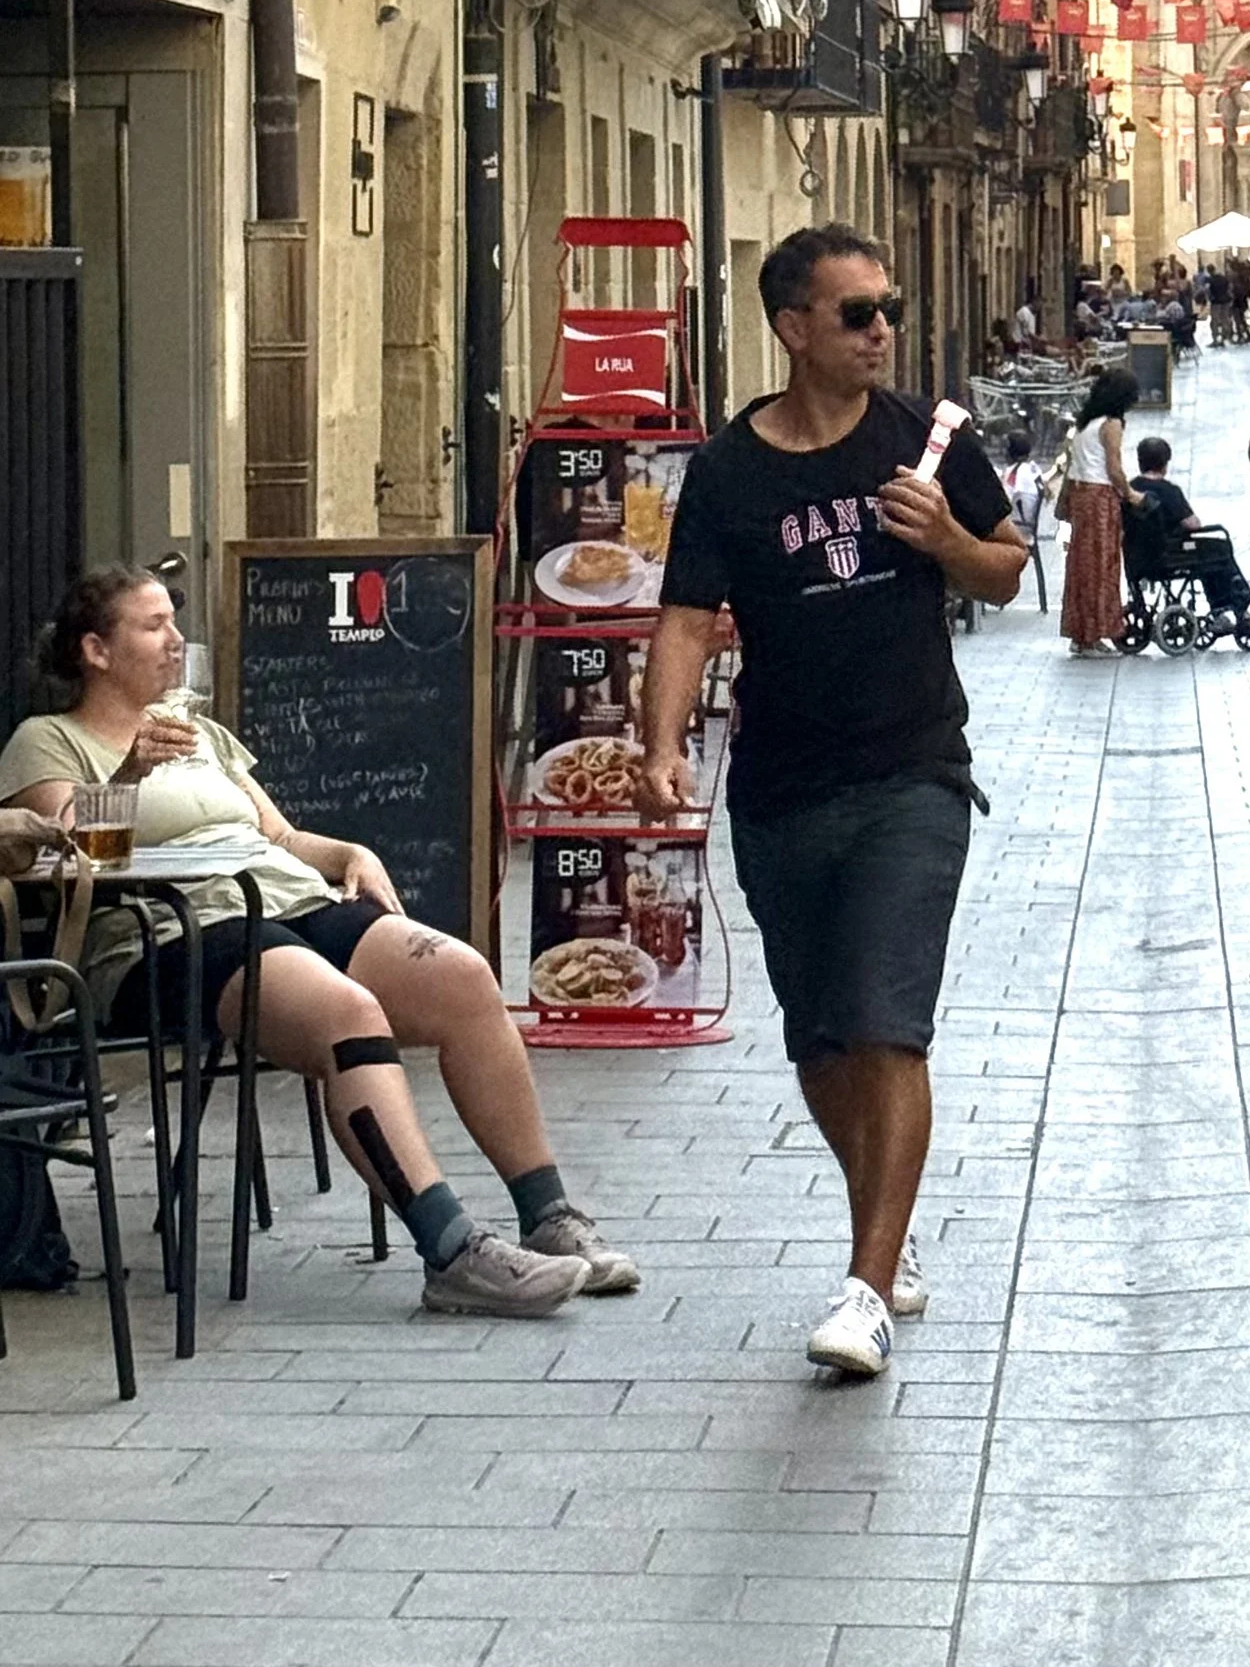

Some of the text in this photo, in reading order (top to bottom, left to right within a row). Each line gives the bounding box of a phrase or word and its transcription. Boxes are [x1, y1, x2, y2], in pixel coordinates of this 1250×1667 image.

[595, 357, 634, 372] LA RUA
[781, 496, 885, 554] GANT
[328, 628, 386, 643] TEMPLO
